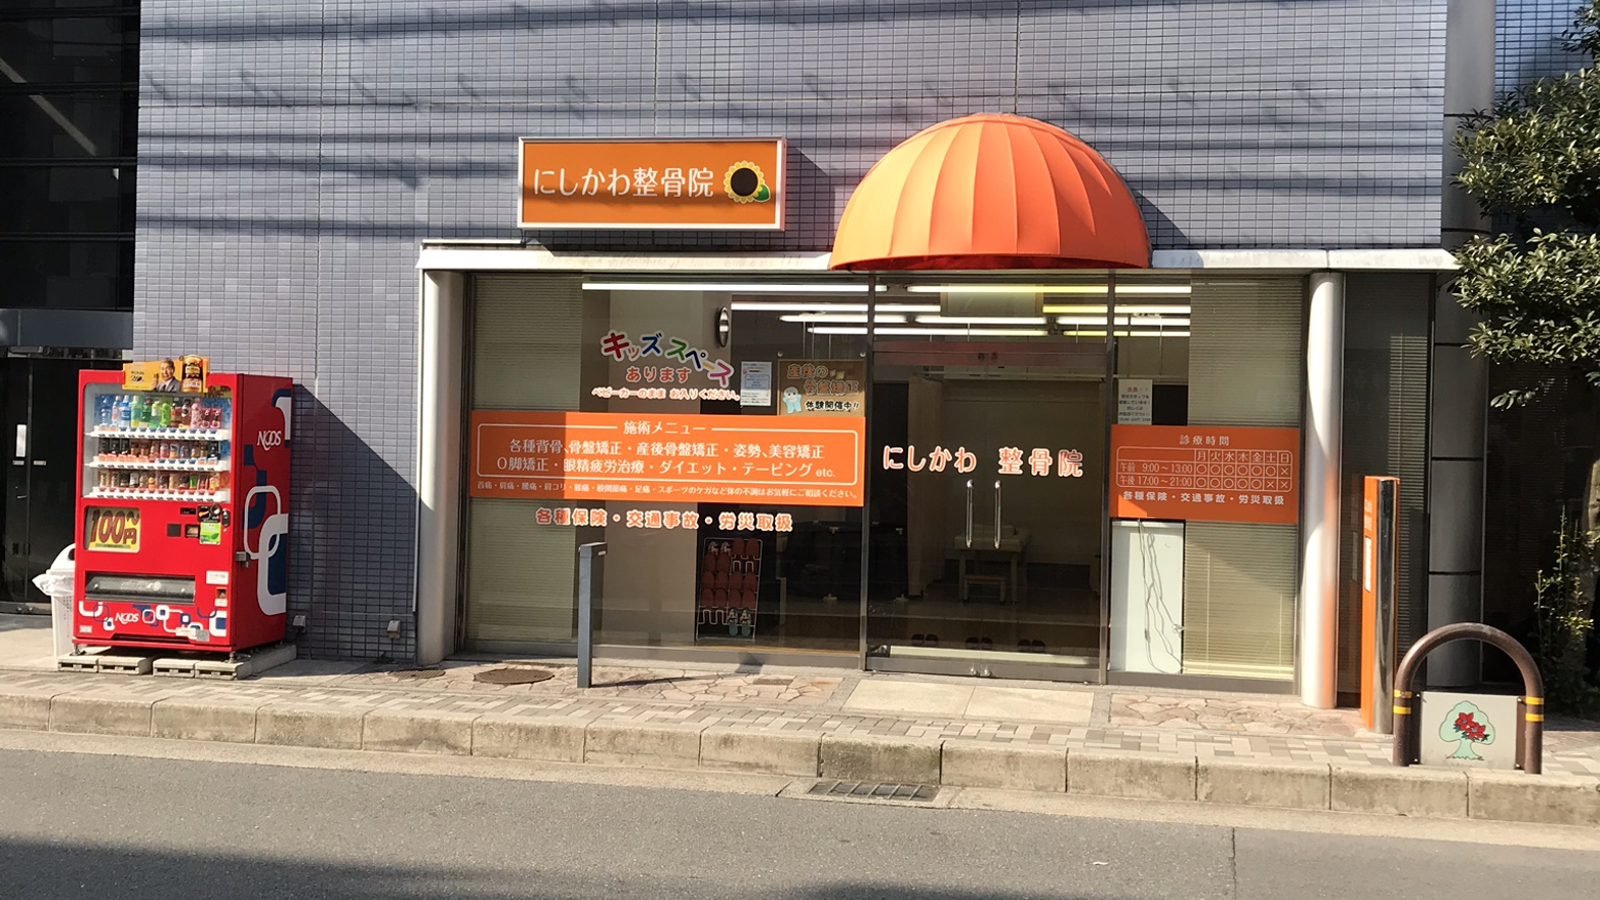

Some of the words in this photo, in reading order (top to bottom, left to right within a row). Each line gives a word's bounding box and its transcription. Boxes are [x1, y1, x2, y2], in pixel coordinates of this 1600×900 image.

[533, 167, 714, 198] にしかわ整骨院
[626, 366, 692, 383] あります
[623, 420, 706, 435] 施術メニュー
[1179, 434, 1231, 447] 診療時間
[883, 445, 977, 474] にしかわ
[998, 446, 1084, 478] 整骨院
[815, 467, 836, 478] etc.
[535, 507, 793, 532] 各種保険・交通事故・労災取扱
